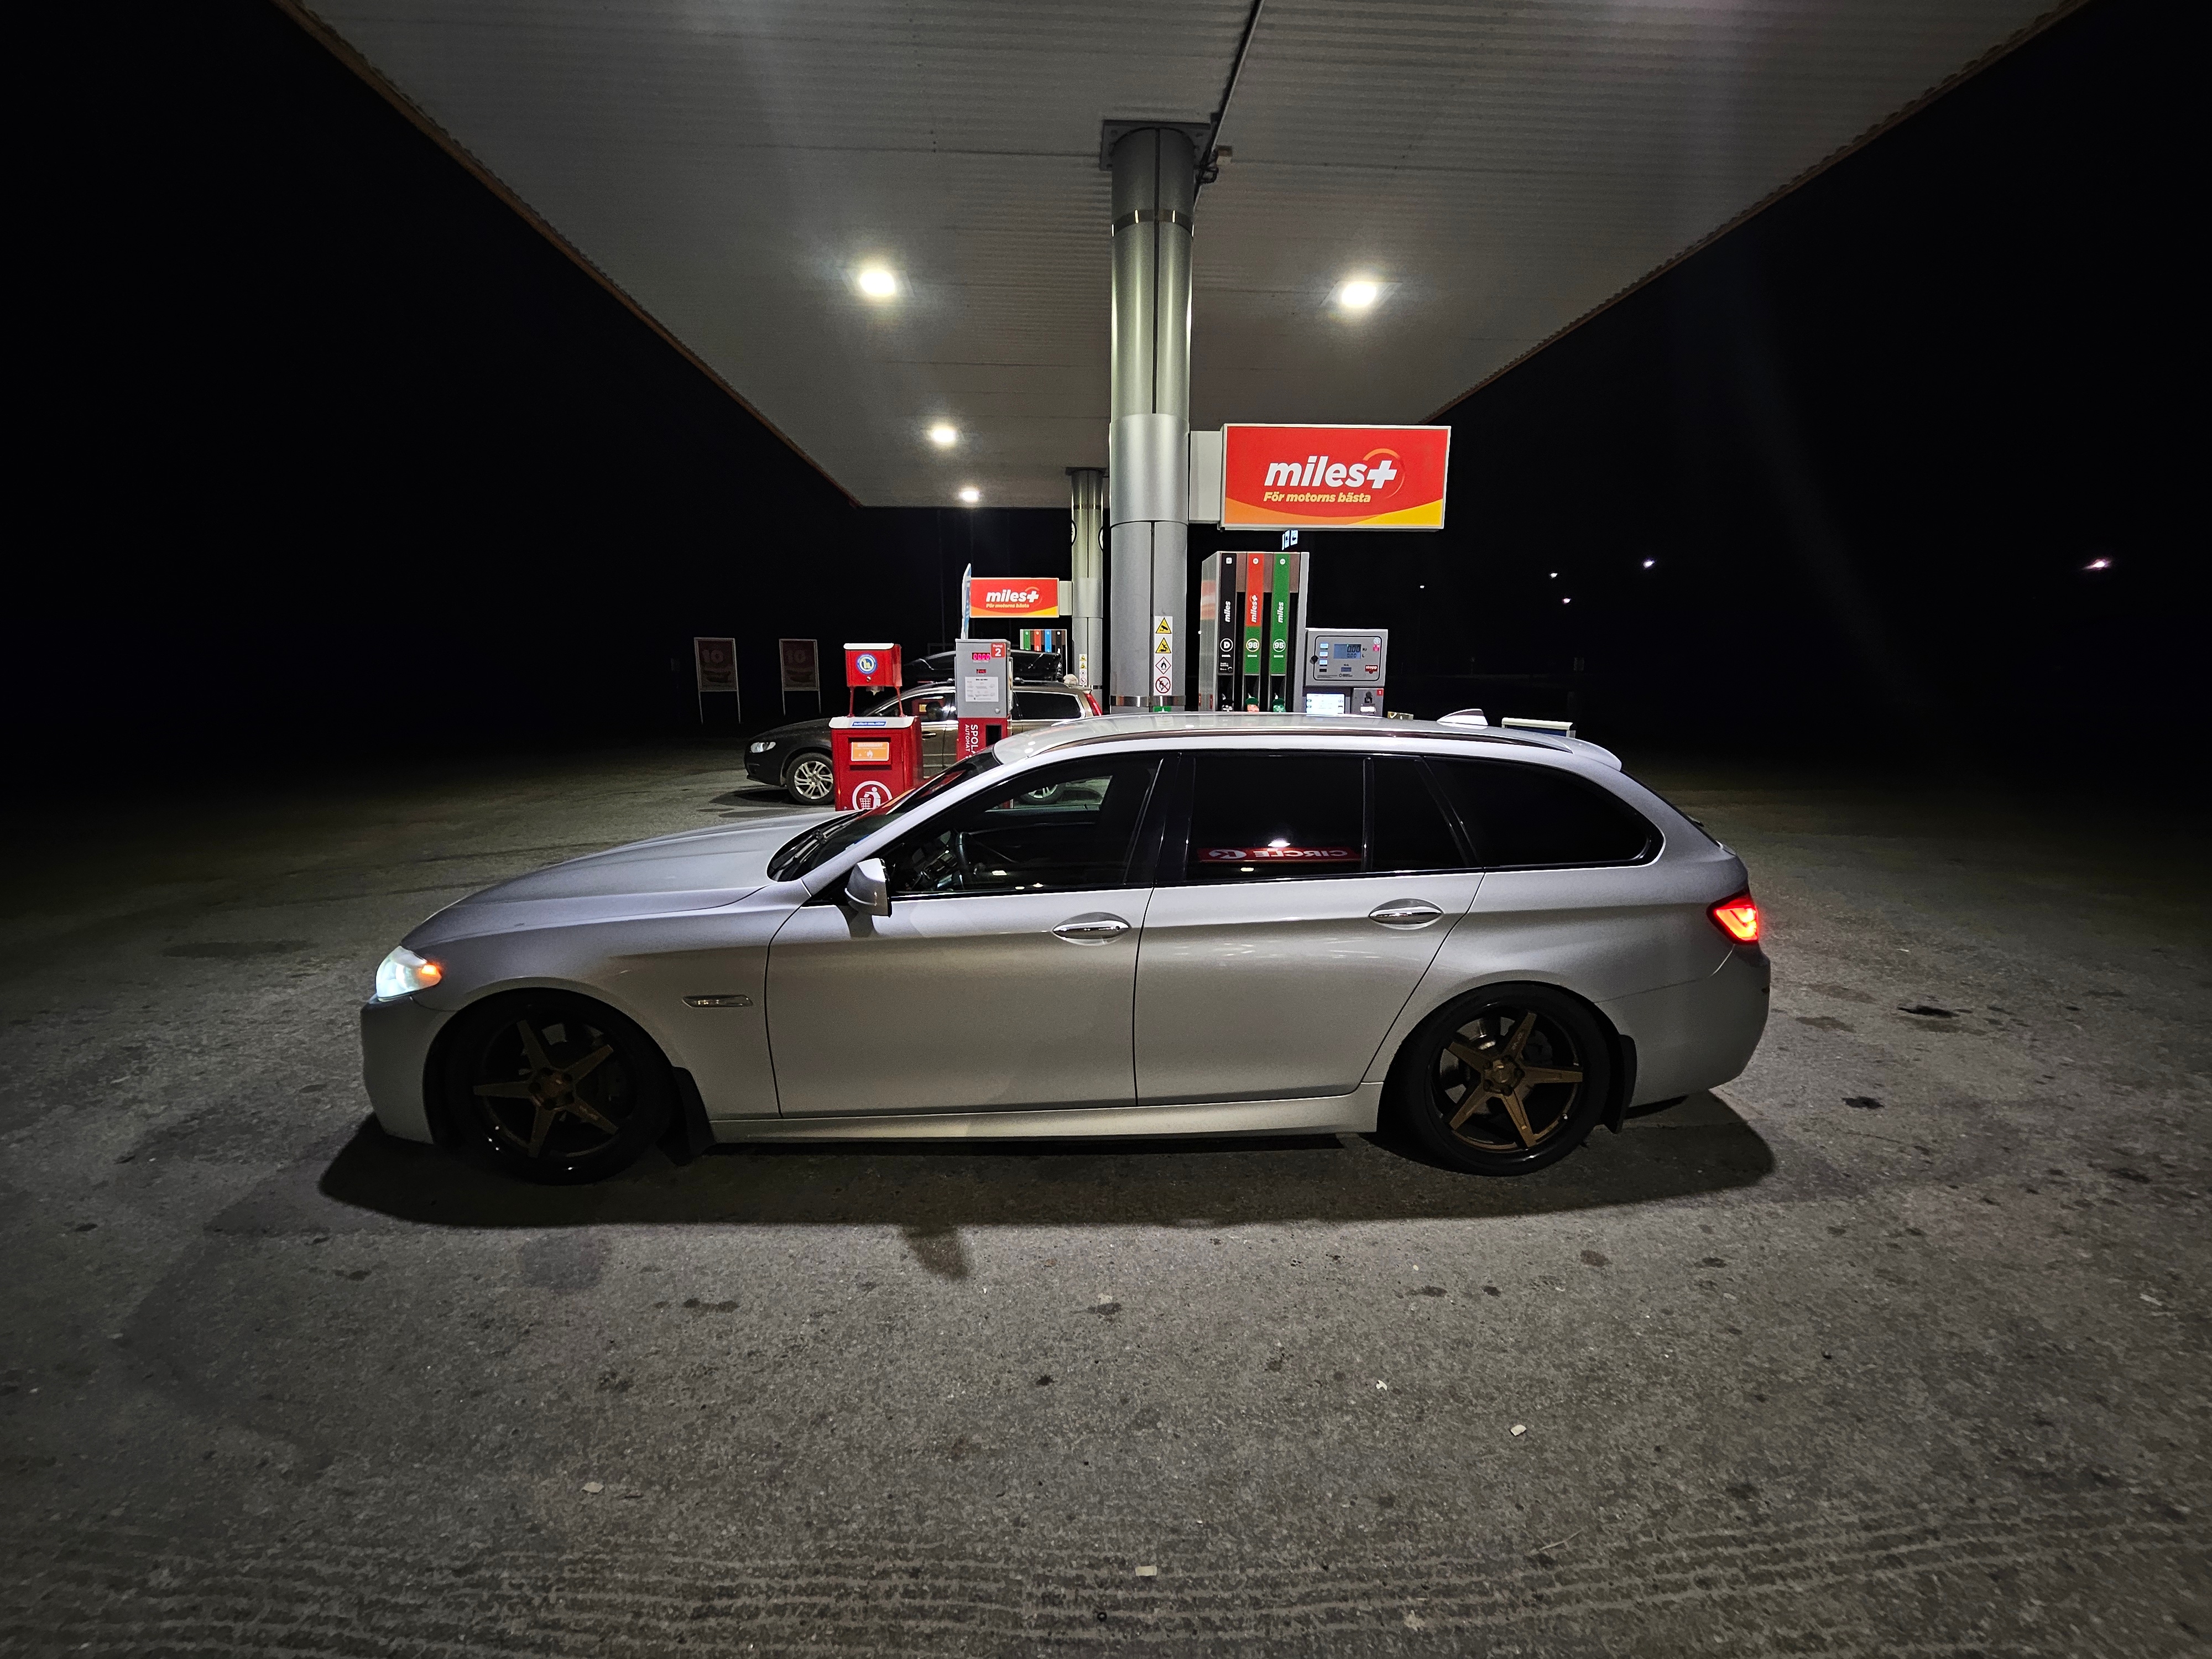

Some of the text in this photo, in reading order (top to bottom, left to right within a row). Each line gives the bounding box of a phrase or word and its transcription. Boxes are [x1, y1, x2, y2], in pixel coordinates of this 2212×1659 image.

[1264, 492, 1371, 503] För motorns bästa
[995, 648, 1001, 656] 2
